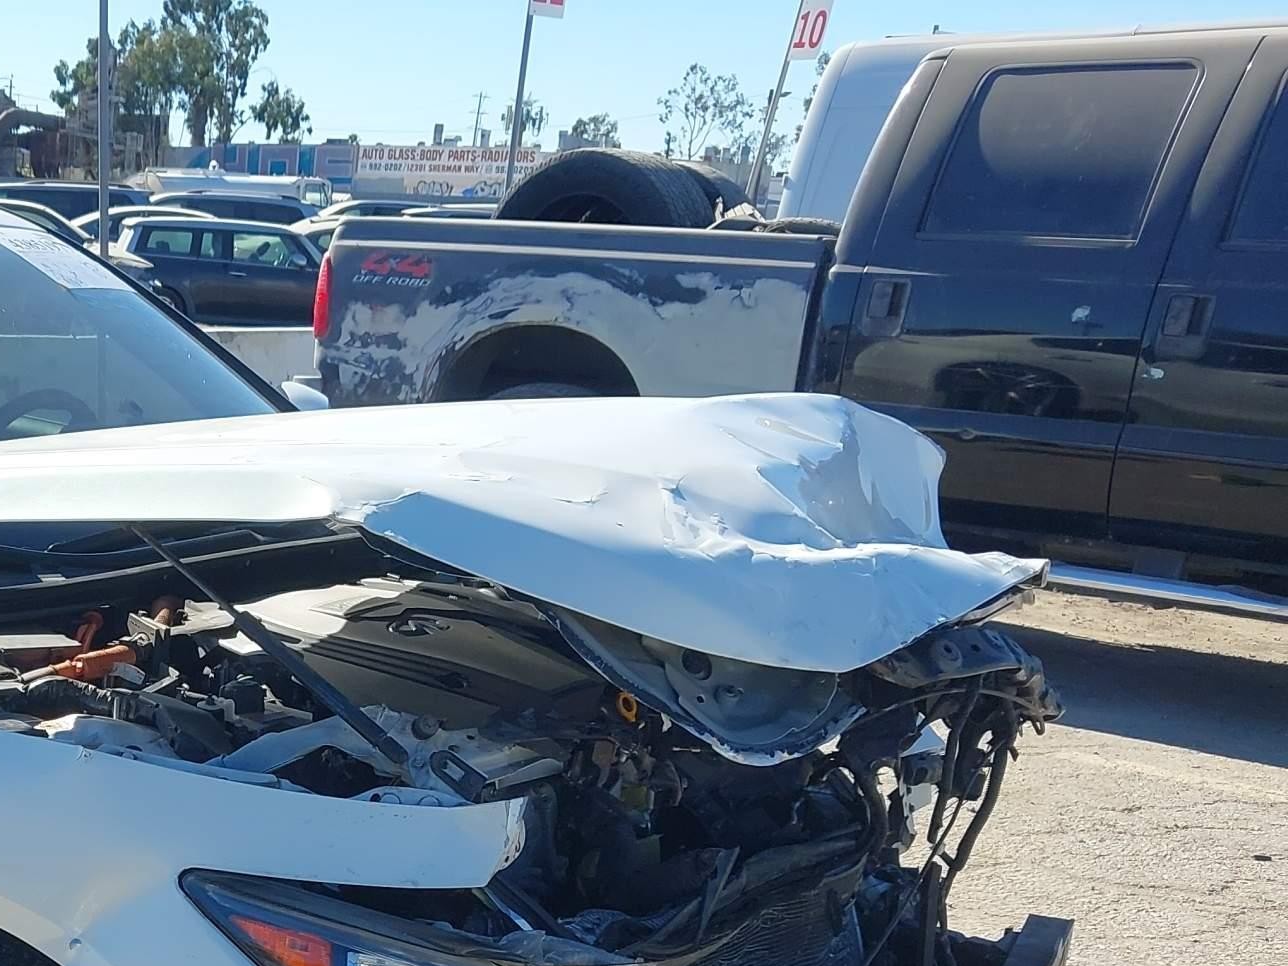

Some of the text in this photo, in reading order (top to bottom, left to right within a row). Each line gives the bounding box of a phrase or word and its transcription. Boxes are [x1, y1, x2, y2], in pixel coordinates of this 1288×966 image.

[792, 10, 828, 49] 10
[361, 148, 385, 161] AUTO
[428, 164, 462, 174] SHERMAN
[352, 274, 432, 288] OFF ROAD
